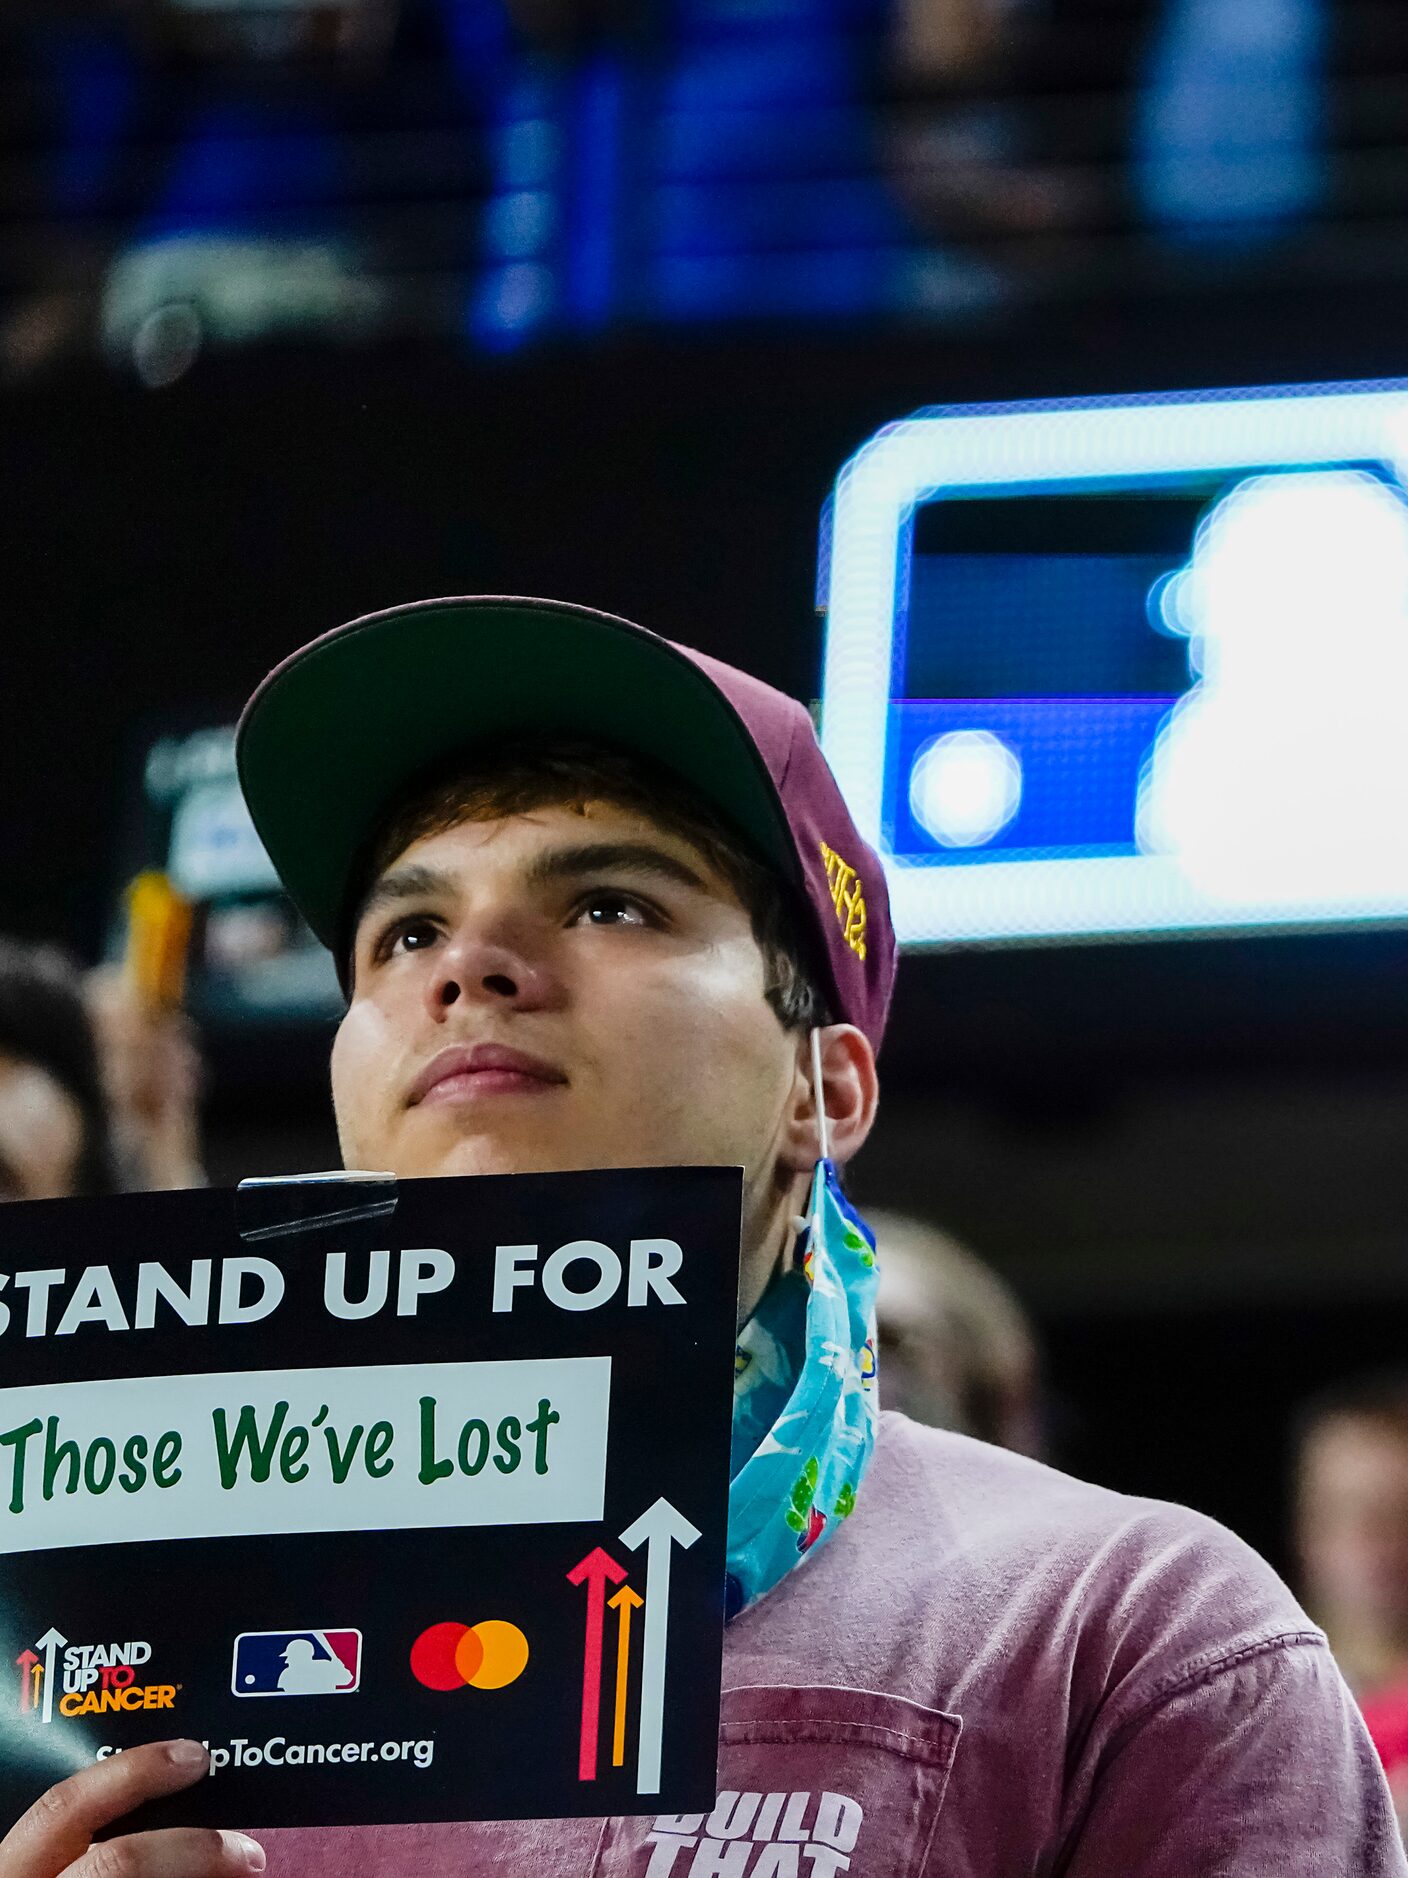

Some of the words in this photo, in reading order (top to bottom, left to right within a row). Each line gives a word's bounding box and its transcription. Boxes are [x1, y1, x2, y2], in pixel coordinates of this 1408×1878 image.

[324, 1249, 455, 1319] UP
[493, 1239, 687, 1312] FOR
[0, 1416, 182, 1513] Those
[213, 1402, 394, 1489] We've
[419, 1397, 560, 1485] Lost
[63, 1641, 152, 1671] STAND
[63, 1668, 99, 1694] UP
[98, 1665, 135, 1690] TO
[59, 1685, 176, 1717] CANCER
[644, 1832, 850, 1878] THAT
